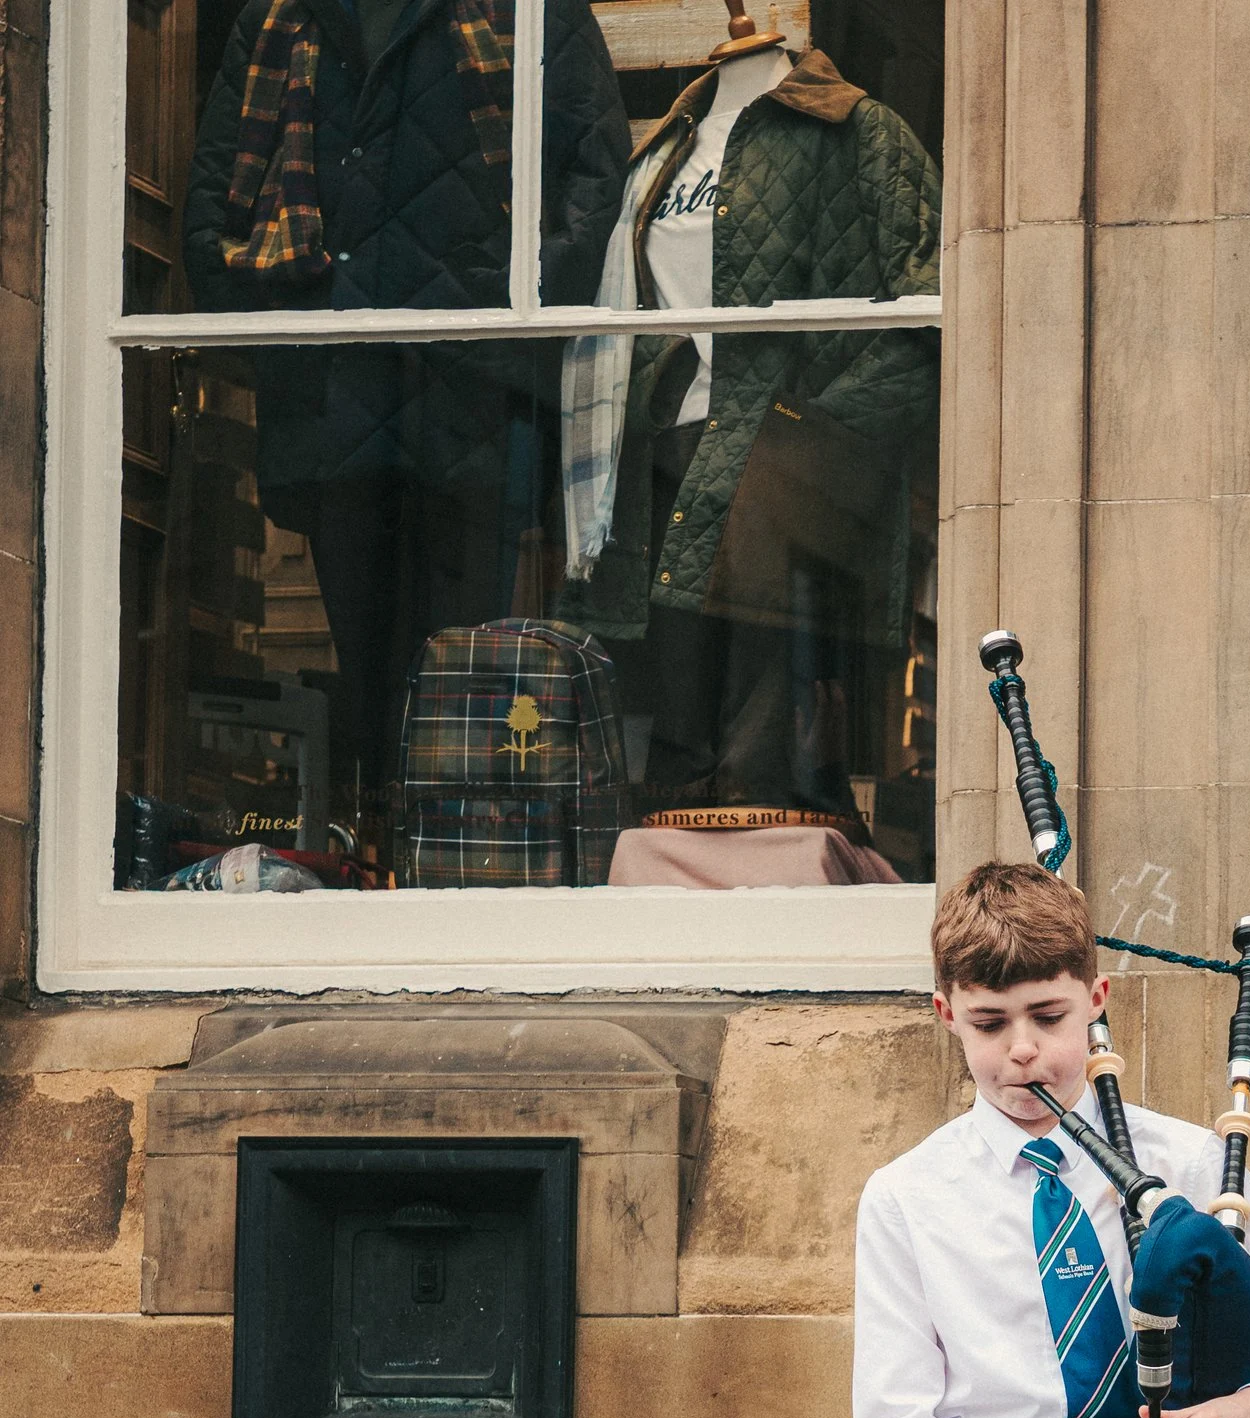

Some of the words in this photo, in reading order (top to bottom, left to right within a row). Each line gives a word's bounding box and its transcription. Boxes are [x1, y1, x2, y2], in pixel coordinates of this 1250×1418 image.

[235, 811, 304, 836] finest
[646, 809, 739, 826] shmeres
[747, 809, 787, 825] and
[1055, 1266, 1071, 1275] West
[1071, 1264, 1094, 1273] Lothian
